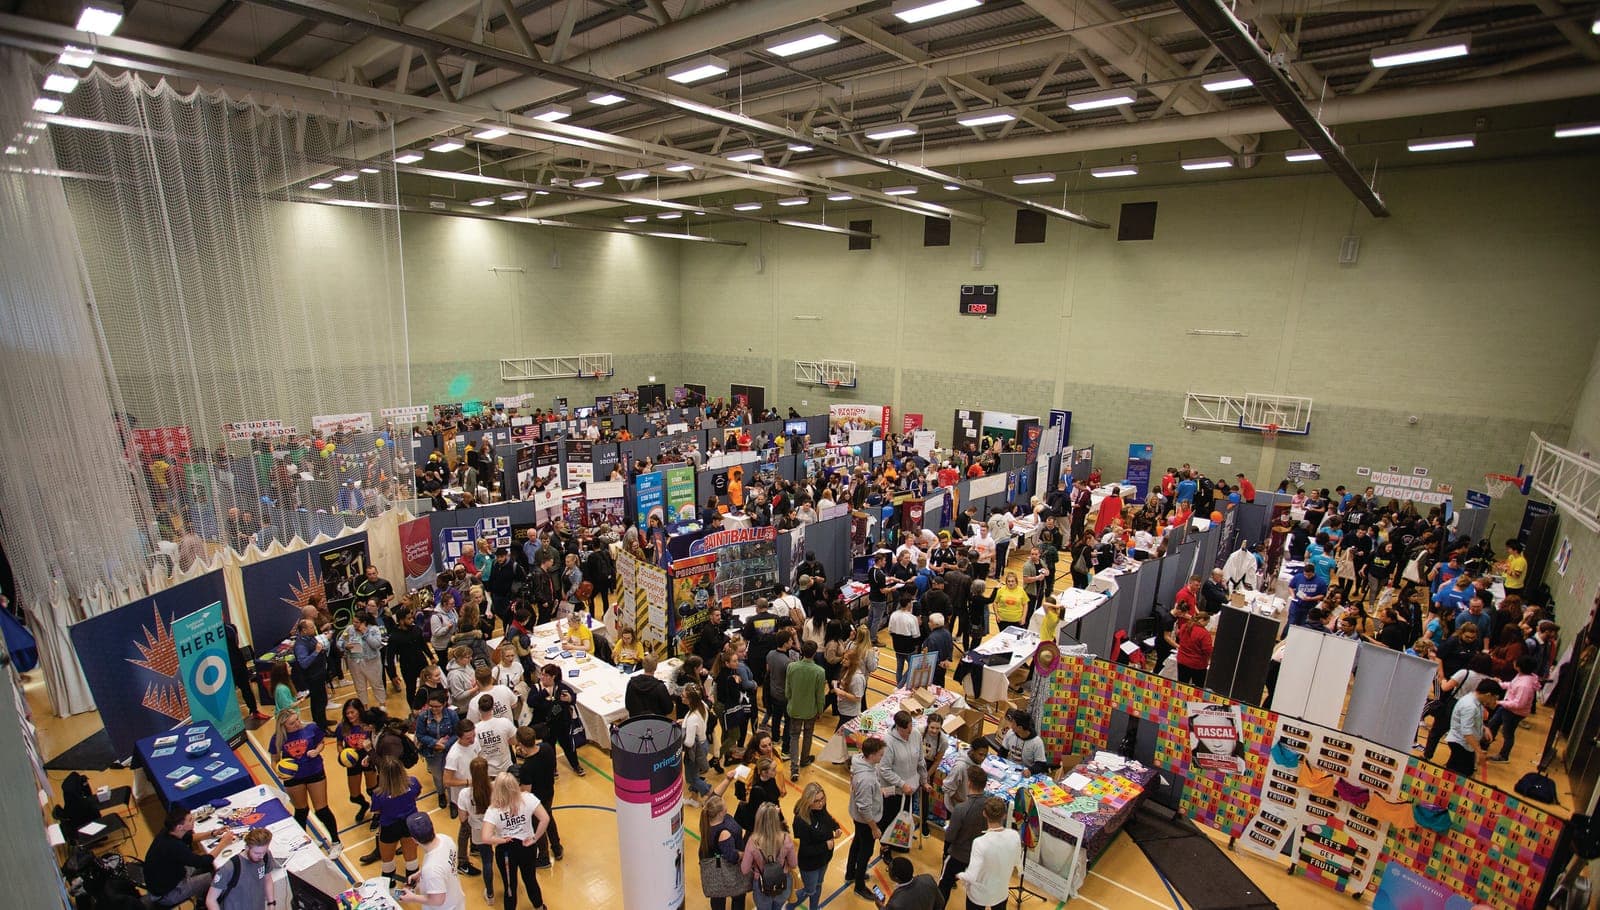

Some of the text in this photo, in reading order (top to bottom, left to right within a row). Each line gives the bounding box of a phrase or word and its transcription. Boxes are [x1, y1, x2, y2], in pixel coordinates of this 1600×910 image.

[234, 420, 282, 431] STUDENT
[231, 428, 297, 440] AMBSADOR
[1372, 473, 1430, 488] WOMEN'S
[640, 567, 665, 585] Student
[181, 625, 224, 657] HERE
[1197, 727, 1235, 738] RASCAL
[1287, 726, 1305, 737] LET'S
[1286, 738, 1299, 747] GET
[1327, 737, 1346, 748] LET'S
[1327, 750, 1341, 760] GET
[1369, 751, 1390, 764] LET'S
[653, 755, 676, 772] prime
[1319, 760, 1344, 772] FRUITY
[1369, 764, 1383, 775] GET
[1276, 771, 1294, 781] LET'S
[1361, 774, 1386, 790] FRUITY
[1276, 783, 1289, 792] GET
[1268, 792, 1293, 804] FRUITY
[506, 814, 527, 828] ARCS
[1264, 812, 1281, 824] LET'S
[1356, 813, 1370, 822] GET
[1261, 824, 1274, 833] GET
[1348, 822, 1372, 835] FRUITY
[1250, 832, 1273, 845] FRUITY
[1319, 836, 1341, 850] LET'S
[1319, 850, 1335, 860] GET
[1310, 857, 1339, 874] FRUITY
